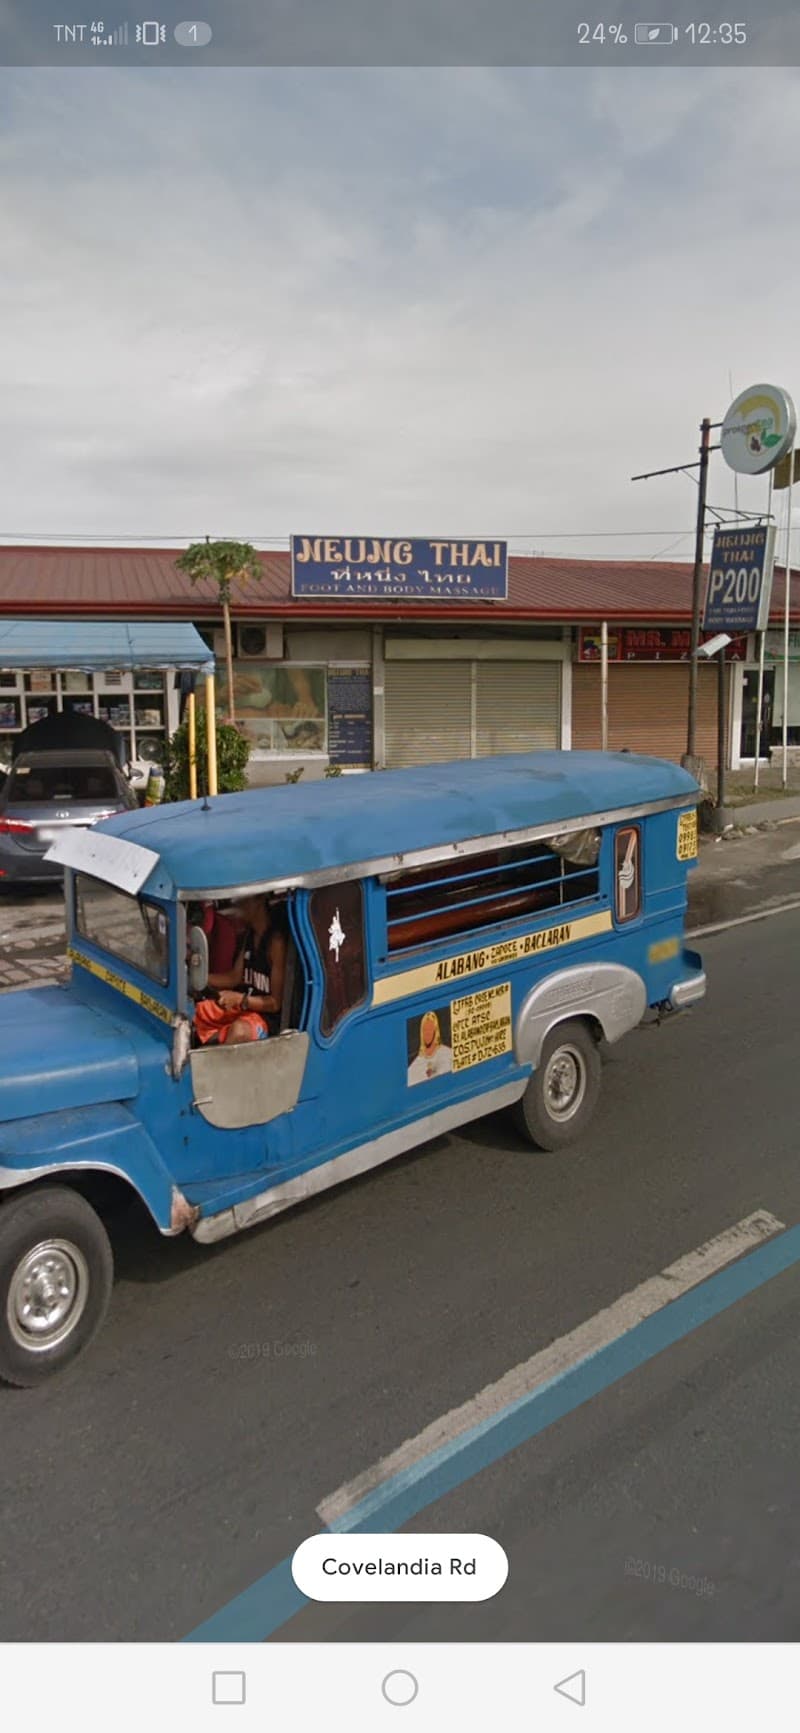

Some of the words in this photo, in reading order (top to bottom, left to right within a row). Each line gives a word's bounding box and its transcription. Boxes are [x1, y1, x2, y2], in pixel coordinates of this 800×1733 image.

[715, 532, 764, 548] NEUNG
[296, 538, 414, 565] NEUNG
[430, 542, 502, 568] THAI
[722, 550, 755, 563] THAI
[417, 569, 472, 583] ไทย
[300, 583, 341, 593] FOOT
[345, 584, 378, 593] AND
[383, 585, 424, 594] BODY
[429, 586, 500, 595] MASSAGE
[708, 567, 761, 604] P200
[435, 951, 485, 982] ALABANG
[490, 940, 518, 959] ZAPOTE
[523, 925, 572, 953] BACLARAN
